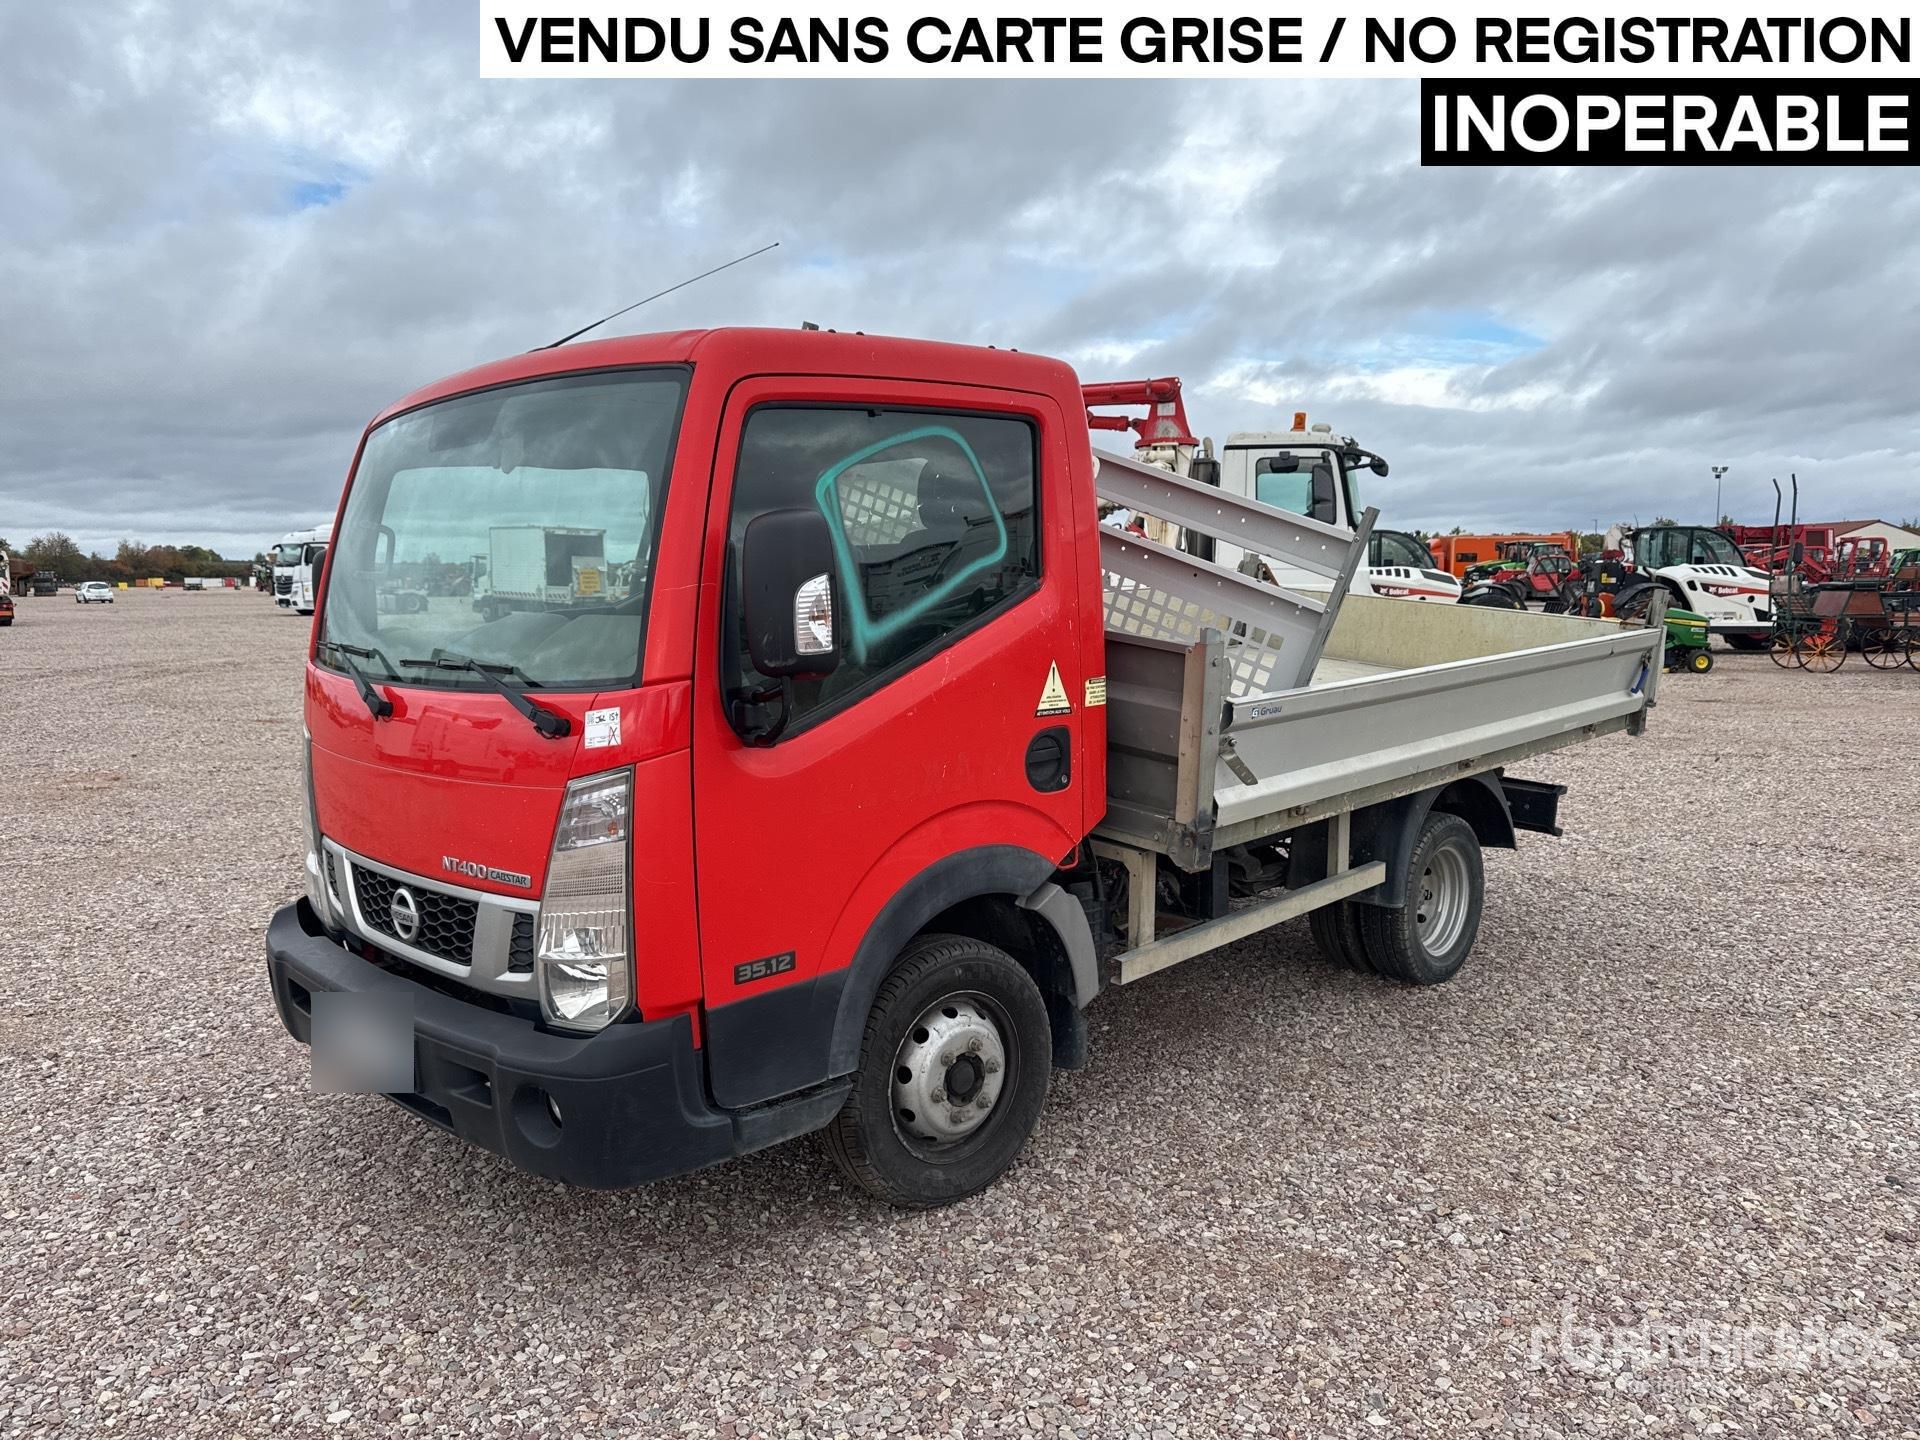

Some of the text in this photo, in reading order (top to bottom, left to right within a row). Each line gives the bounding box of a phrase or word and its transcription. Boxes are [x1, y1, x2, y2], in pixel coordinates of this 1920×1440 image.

[1718, 586, 1738, 594] Bobcat
[1261, 706, 1282, 715] Gruau
[442, 855, 527, 885] NT400 CABSTAR
[738, 955, 791, 982] 35.12
